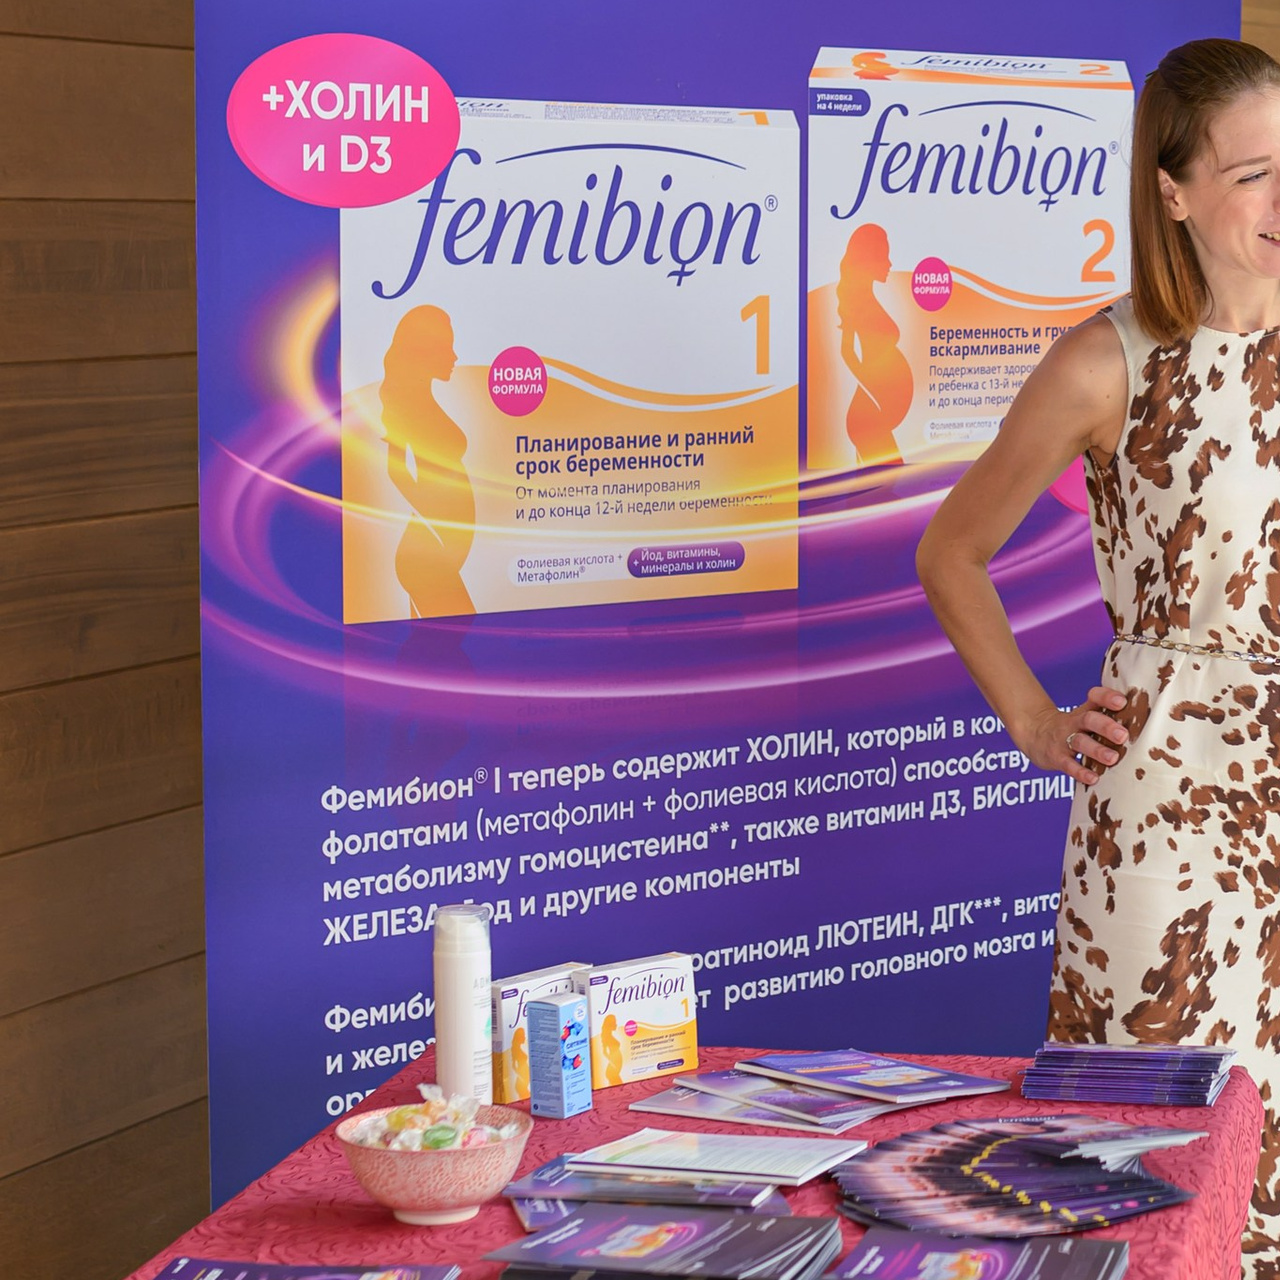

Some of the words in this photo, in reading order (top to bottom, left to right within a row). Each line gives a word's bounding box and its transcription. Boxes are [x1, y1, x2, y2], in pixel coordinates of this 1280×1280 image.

[261, 80, 430, 124] +ХОЛИН
[816, 93, 853, 103] упаковка
[816, 102, 826, 110] на
[827, 102, 833, 110] 4
[834, 102, 862, 112] недели
[302, 144, 326, 172] и
[340, 135, 393, 174] D3
[1080, 219, 1116, 282] 2
[914, 273, 949, 285] НОВАЯ
[913, 286, 950, 295] ФОРМУЛА
[740, 294, 771, 375] 1
[929, 325, 1029, 343] Беременность
[1032, 327, 1042, 338] и
[929, 342, 1041, 360] вскармливание
[493, 366, 543, 382] НОВАЯ
[929, 363, 1002, 378] Поддерживает
[492, 383, 544, 395] ФОРМУЛА
[929, 382, 936, 391] и
[938, 378, 979, 394] ребенка
[981, 381, 987, 390] с
[989, 378, 1010, 390] 13-й
[929, 398, 936, 407] и
[938, 397, 950, 409] до
[953, 395, 983, 408] конца
[515, 432, 662, 456] Планирование
[667, 433, 680, 447] и
[685, 425, 754, 451] ранний
[515, 457, 561, 480] срок
[566, 453, 705, 477] беременности
[515, 486, 534, 500] От
[538, 483, 599, 499] момента
[602, 478, 701, 500] планирования
[515, 508, 525, 520] и
[528, 507, 546, 522] до
[549, 504, 591, 521] конца
[596, 500, 625, 516] 12-й
[627, 499, 676, 515] недели
[516, 554, 571, 570] Фолиевая
[573, 553, 616, 568] кислота
[640, 546, 665, 564] Йод,
[666, 545, 722, 561] витамины,
[640, 559, 695, 575] минералы
[696, 560, 704, 570] и
[705, 556, 737, 569] холин
[509, 761, 606, 792] теперь
[612, 744, 741, 782] содержит
[746, 728, 841, 764] ХОЛИН,
[847, 716, 947, 752] который
[953, 717, 965, 737] в
[321, 819, 468, 863] фолатами
[476, 797, 635, 841] (метафолин
[664, 779, 788, 819] фолиевая
[794, 756, 898, 797] кислота)
[323, 855, 511, 902] метаболизму
[744, 811, 819, 843] также
[826, 797, 924, 832] витамин
[930, 788, 966, 820] Д3,
[520, 895, 537, 917] и
[543, 881, 638, 918] другие
[645, 856, 800, 899] компоненты
[815, 910, 926, 952] ЛЮТЕИН,
[326, 1053, 344, 1075] и
[724, 965, 845, 1010] развитию
[850, 941, 969, 981] головного
[973, 932, 1036, 961] мозга
[1041, 928, 1055, 947] и
[680, 998, 690, 1018] 1
